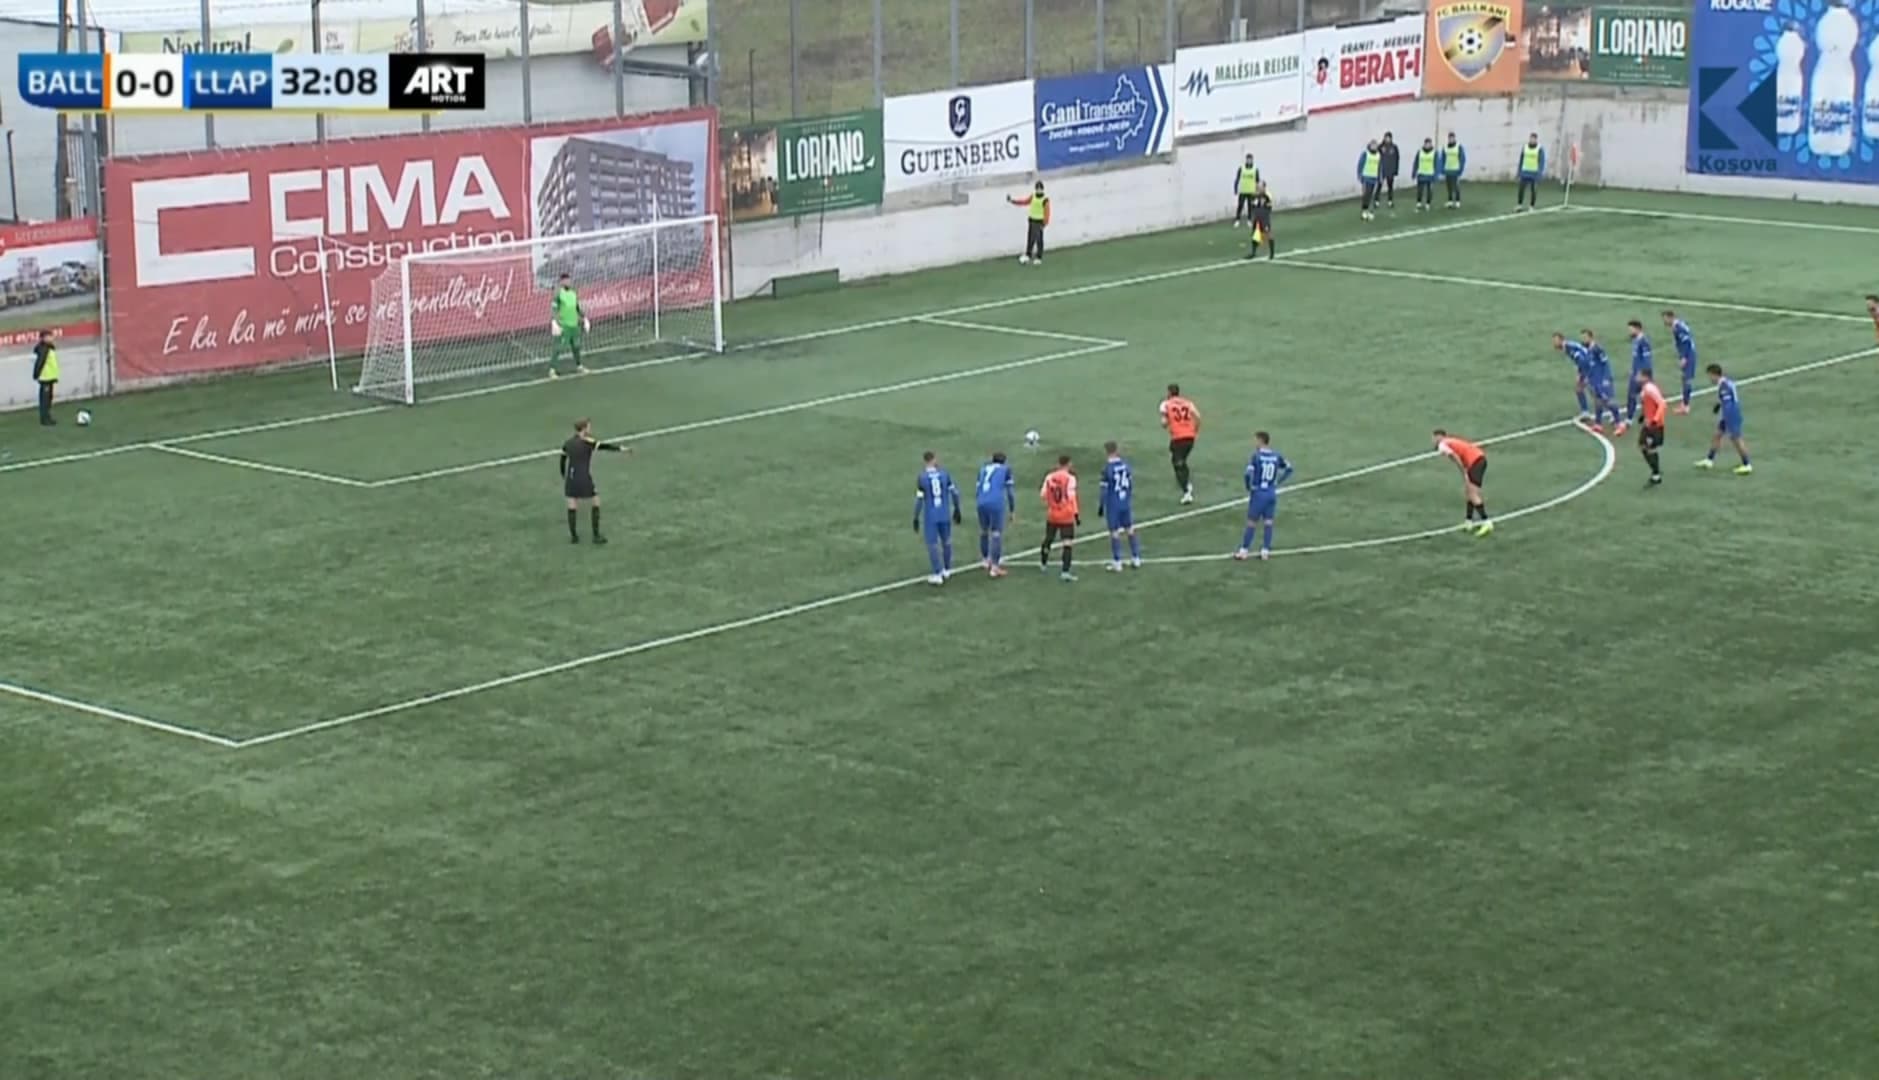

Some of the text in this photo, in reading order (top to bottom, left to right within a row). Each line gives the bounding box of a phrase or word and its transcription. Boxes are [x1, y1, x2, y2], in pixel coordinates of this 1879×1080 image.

[1598, 18, 1685, 57] LORIANO
[1263, 55, 1300, 76] REISEN
[1340, 47, 1421, 89] BERAT-I
[1042, 97, 1136, 125] Gani Transport
[785, 130, 865, 181] LORIANO
[900, 133, 1020, 175] GUTENBERG
[268, 155, 512, 242] CIMA
[270, 228, 515, 278] Construction
[163, 315, 189, 355] E
[263, 309, 290, 341] më
[345, 305, 367, 325] se
[1172, 406, 1190, 422] 32
[1114, 470, 1130, 492] 24
[1261, 462, 1275, 480] 10
